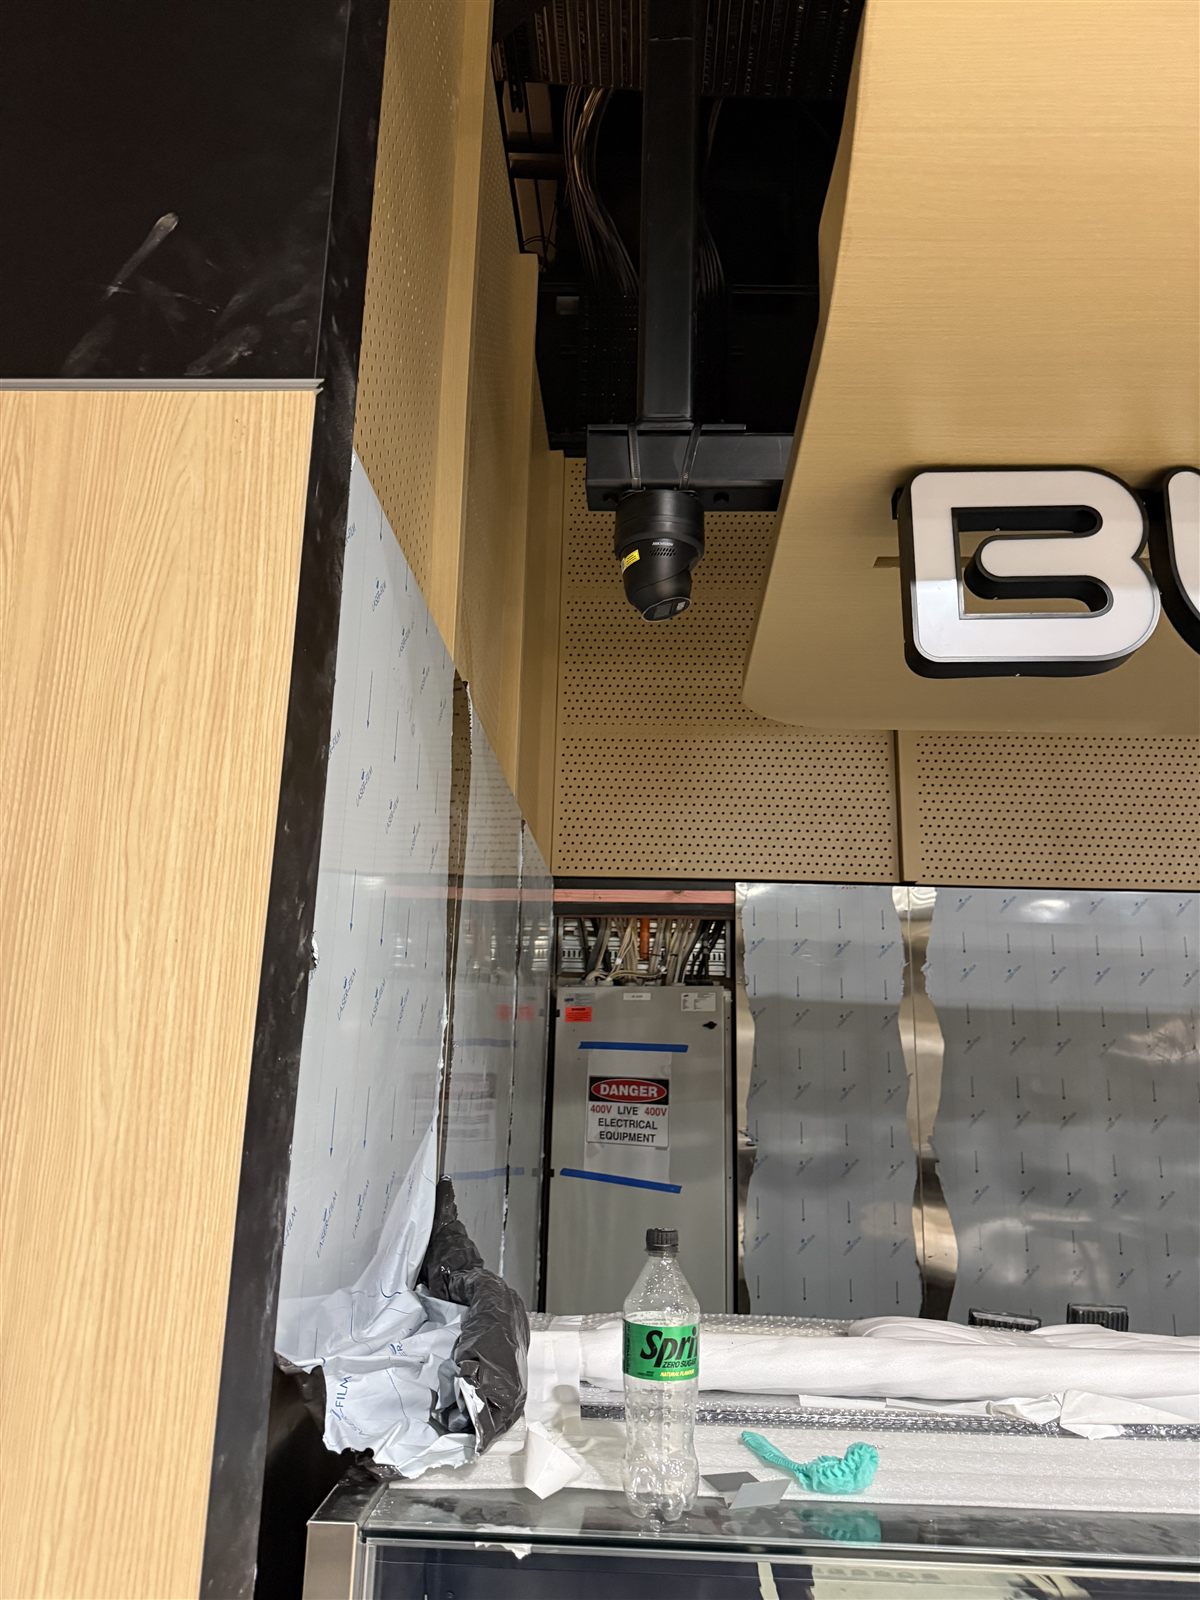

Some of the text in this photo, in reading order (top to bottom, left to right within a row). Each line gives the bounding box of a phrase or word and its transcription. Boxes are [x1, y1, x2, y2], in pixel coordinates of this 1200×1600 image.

[909, 468, 1200, 664] B
[599, 1084, 658, 1098] DANGER
[590, 1104, 667, 1117] 400V LIVE 400V
[598, 1118, 658, 1130] ELECTRICAL
[599, 1131, 656, 1143] EQUIPMENT
